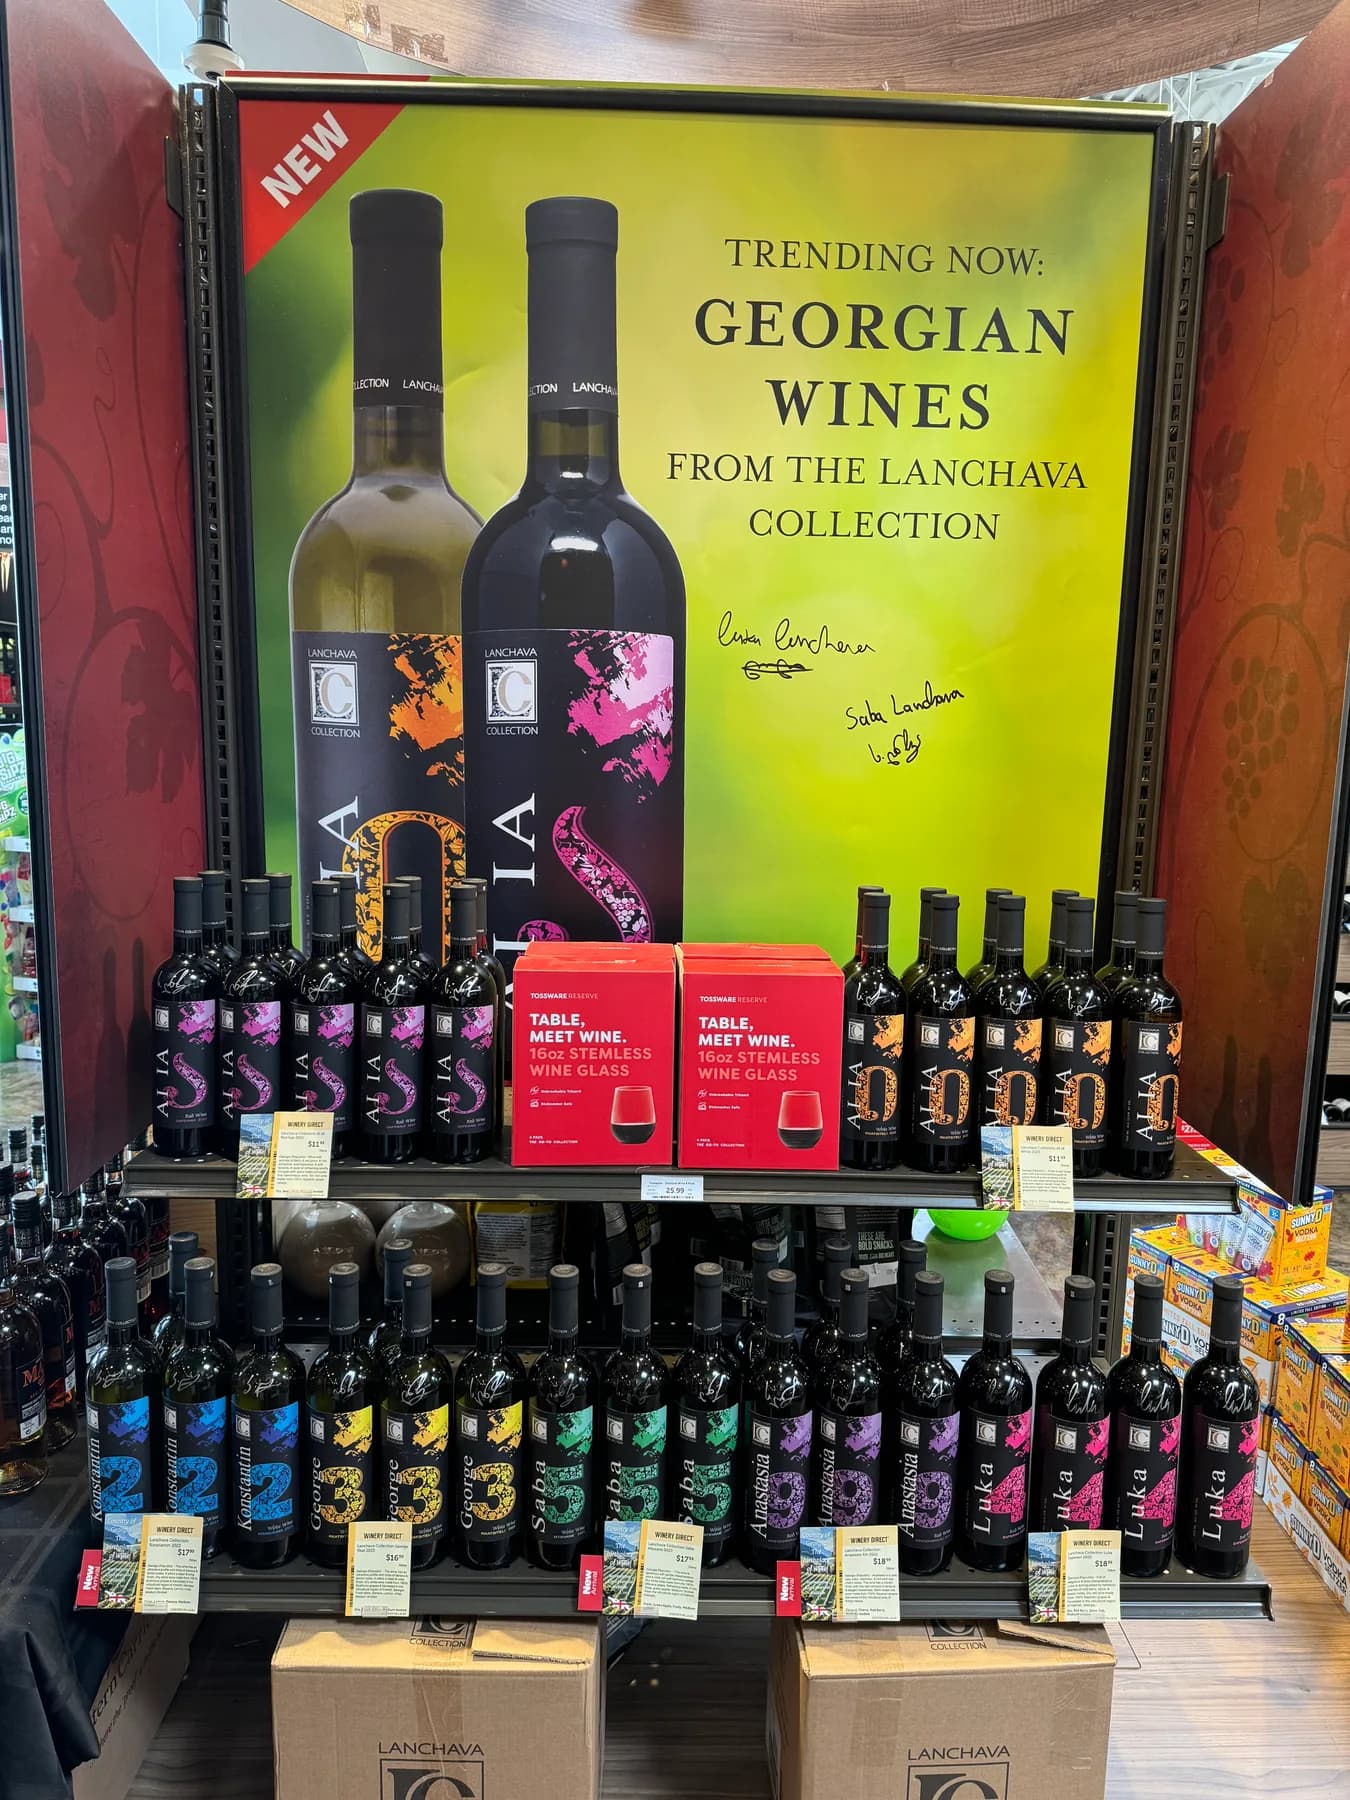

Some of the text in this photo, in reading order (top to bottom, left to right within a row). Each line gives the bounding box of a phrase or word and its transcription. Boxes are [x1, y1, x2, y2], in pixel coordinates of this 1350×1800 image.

[261, 110, 349, 208] NEW
[725, 239, 1045, 277] TRENDING NOW:
[695, 298, 1076, 356] GEORGIAN
[353, 378, 389, 391] LLECTION
[766, 379, 991, 431] WINES
[667, 453, 1088, 489] FROM THE LANCHAVA
[749, 508, 1000, 540] COLLECTION
[307, 648, 357, 659] LANCHAVA
[484, 647, 538, 658] LANCHAVA
[311, 726, 361, 738] COLLECTION
[486, 726, 539, 736] COLLECTION
[529, 1013, 586, 1028] TABLE,
[529, 1030, 627, 1043] MEET WINE.
[698, 1016, 754, 1032] TABLE,
[698, 1033, 796, 1048] MEET WINE.
[529, 1047, 652, 1060] 16oz STEMLESS
[529, 1064, 630, 1077] WINE GLASS
[698, 1050, 821, 1065] 16oz STEMLESS
[698, 1067, 798, 1081] WINE GLASS
[858, 1231, 885, 1241] THESE ARE
[858, 1241, 872, 1251] BOLD
[1294, 1226, 1318, 1237] VODKA
[1162, 1319, 1190, 1346] NNYD
[89, 1437, 103, 1522] Konstantin
[100, 1456, 144, 1512] 2
[166, 1437, 178, 1514] onstantin
[176, 1456, 219, 1513] 2
[236, 1446, 252, 1531] Konstantin
[249, 1462, 293, 1521] 2
[311, 1457, 324, 1531] George
[319, 1466, 366, 1524] 3
[397, 1466, 444, 1524] 3
[461, 1455, 477, 1529] George
[471, 1462, 517, 1521] 3
[531, 1460, 546, 1533] Saba
[543, 1464, 585, 1524] 5
[606, 1460, 622, 1521] aba
[617, 1463, 659, 1521] 5
[690, 1461, 732, 1521] 5
[750, 1454, 770, 1538] Anastasia
[767, 1471, 805, 1529] 9
[832, 1469, 873, 1526] 9
[897, 1453, 918, 1538] Anastasia
[914, 1471, 953, 1529] 9
[973, 1463, 994, 1535] Luka
[988, 1463, 1026, 1524] 4
[1052, 1470, 1073, 1530] uka
[1068, 1470, 1104, 1530] 4
[1138, 1467, 1176, 1529] 4
[1218, 1469, 1255, 1529] 4
[1125, 1468, 1147, 1541] Luka
[1202, 1469, 1226, 1542] Luka
[654, 1531, 693, 1541] WINERY DIRECT
[83, 1565, 95, 1591] New
[582, 1569, 593, 1595] New
[780, 1576, 789, 1601] New
[1322, 1551, 1348, 1588] VODKA
[409, 1637, 466, 1649] COLLECTION
[930, 1641, 987, 1650] COLLECTION
[378, 1742, 485, 1756] LANCHAVA
[907, 1745, 1011, 1761] LANCHAVA
